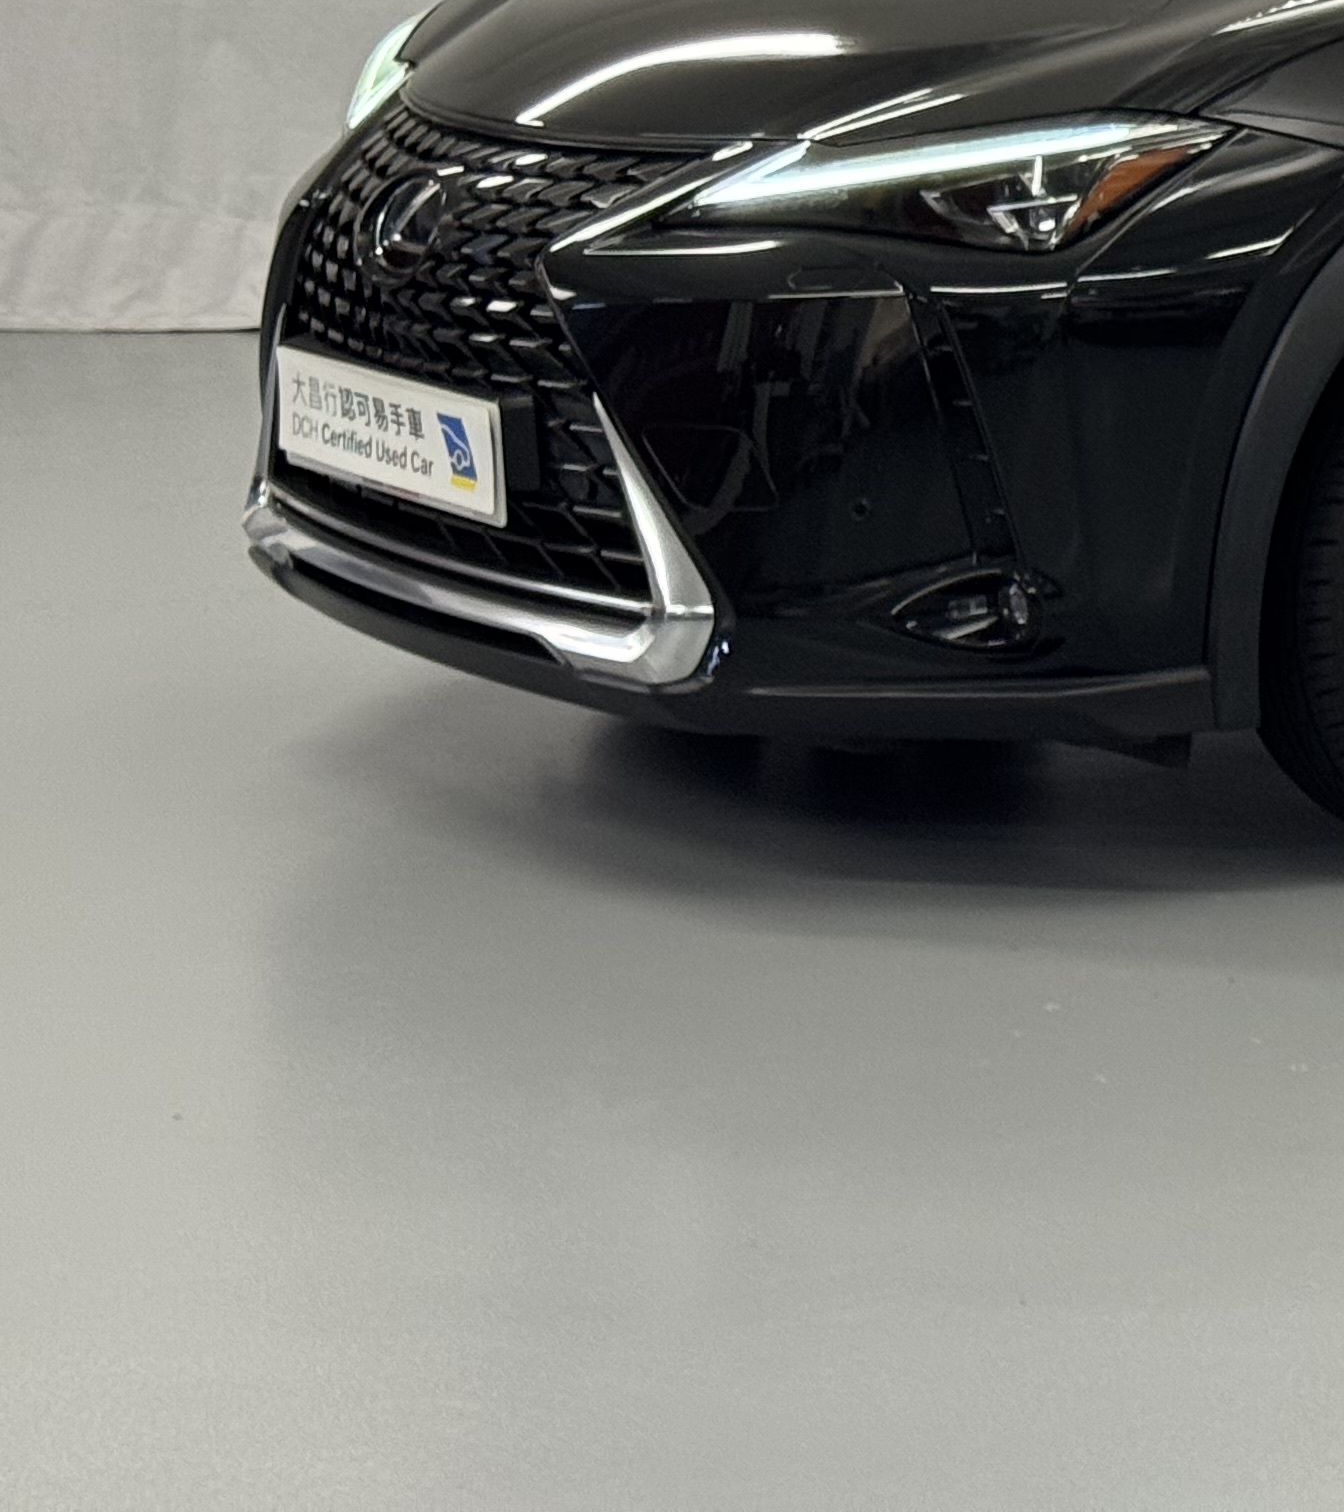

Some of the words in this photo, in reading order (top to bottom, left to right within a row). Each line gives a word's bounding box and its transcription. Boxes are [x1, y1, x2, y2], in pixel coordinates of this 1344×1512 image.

[292, 410, 319, 441] DCH
[321, 422, 373, 459] Certified
[375, 438, 408, 470] Used
[410, 449, 434, 478] Car
